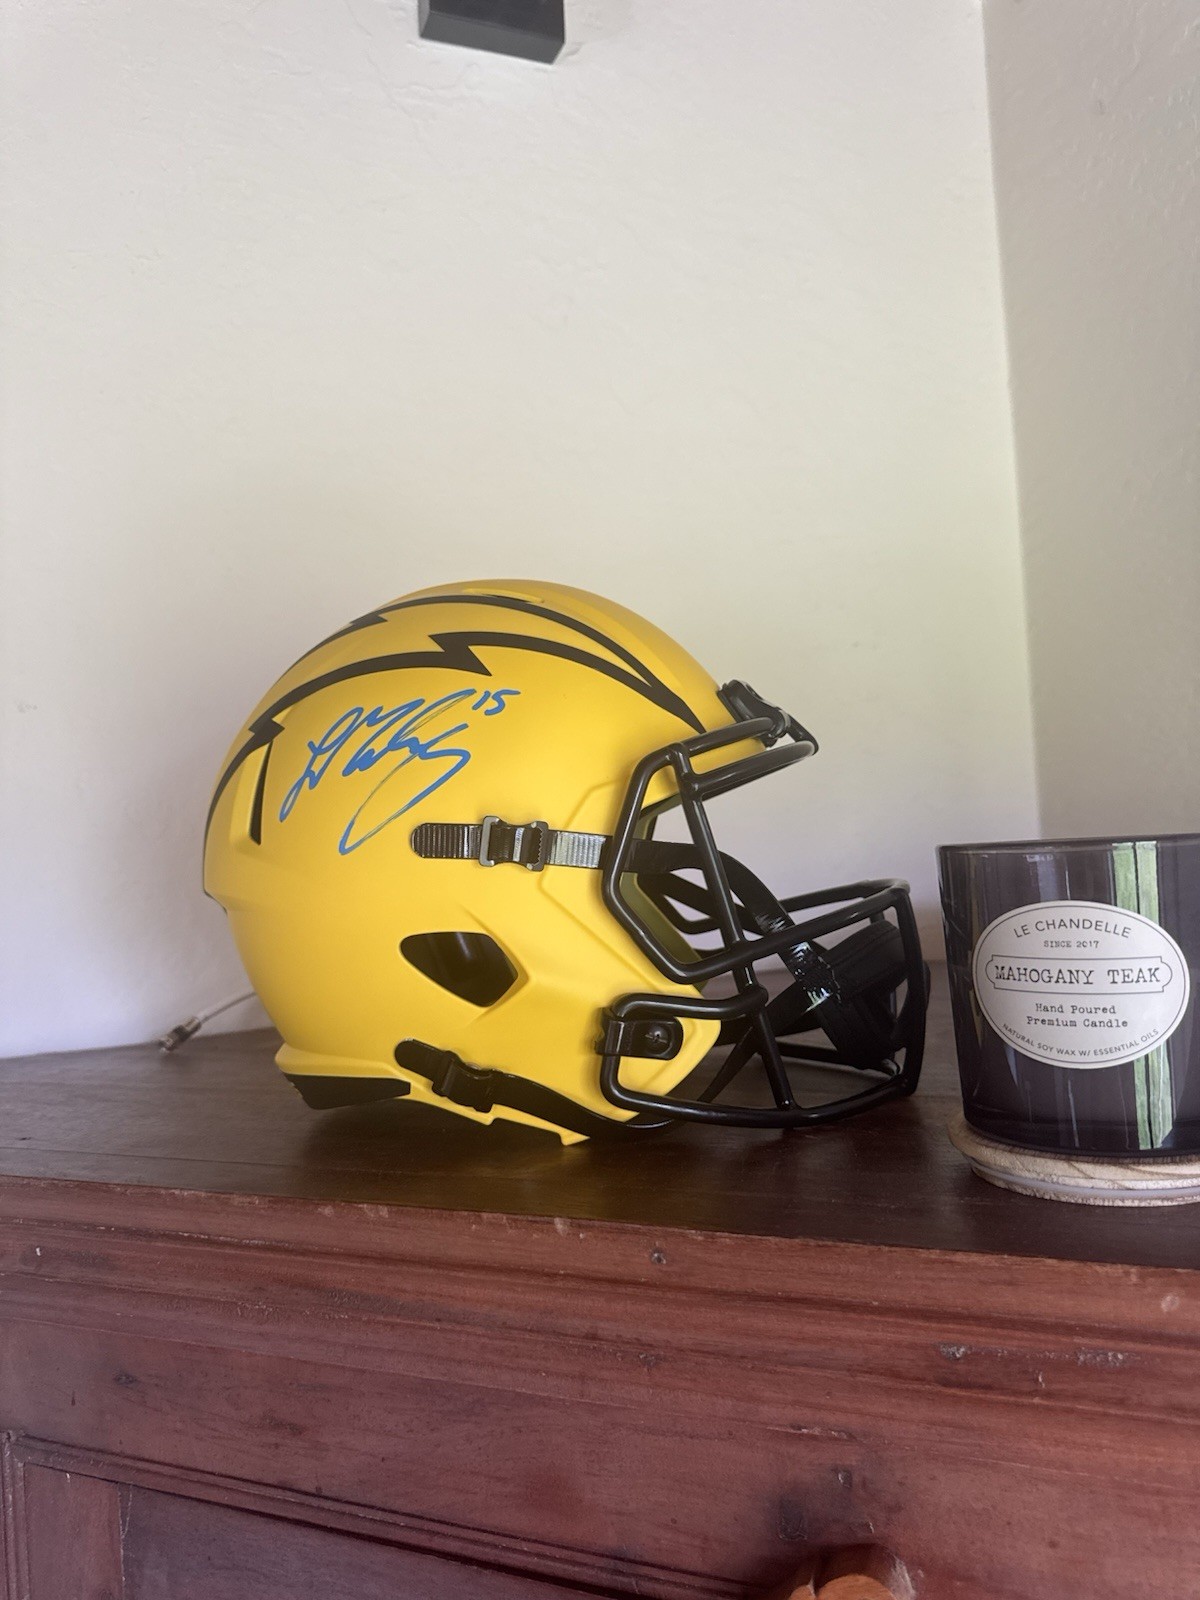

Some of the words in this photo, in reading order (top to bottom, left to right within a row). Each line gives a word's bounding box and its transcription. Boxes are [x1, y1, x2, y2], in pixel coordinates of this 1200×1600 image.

[1013, 924, 1031, 938] LE
[1035, 918, 1132, 939] CHANDELLE
[1043, 940, 1072, 948] SINCE
[1076, 940, 1100, 948] 2017
[995, 965, 1094, 985] MAHOGANY
[1107, 967, 1160, 984] TEAK
[1035, 1003, 1064, 1014] Hand
[1070, 1005, 1116, 1015] Poured
[1026, 1016, 1077, 1027] Premium
[1083, 1018, 1128, 1028] Candle
[1002, 1023, 1035, 1047] NATURAL
[1037, 1042, 1053, 1052] SOY
[1056, 1047, 1076, 1056] WAX
[1079, 1048, 1091, 1057] W/
[1093, 1040, 1140, 1056] ESSENTIAL
[1140, 1028, 1159, 1042] OILS
